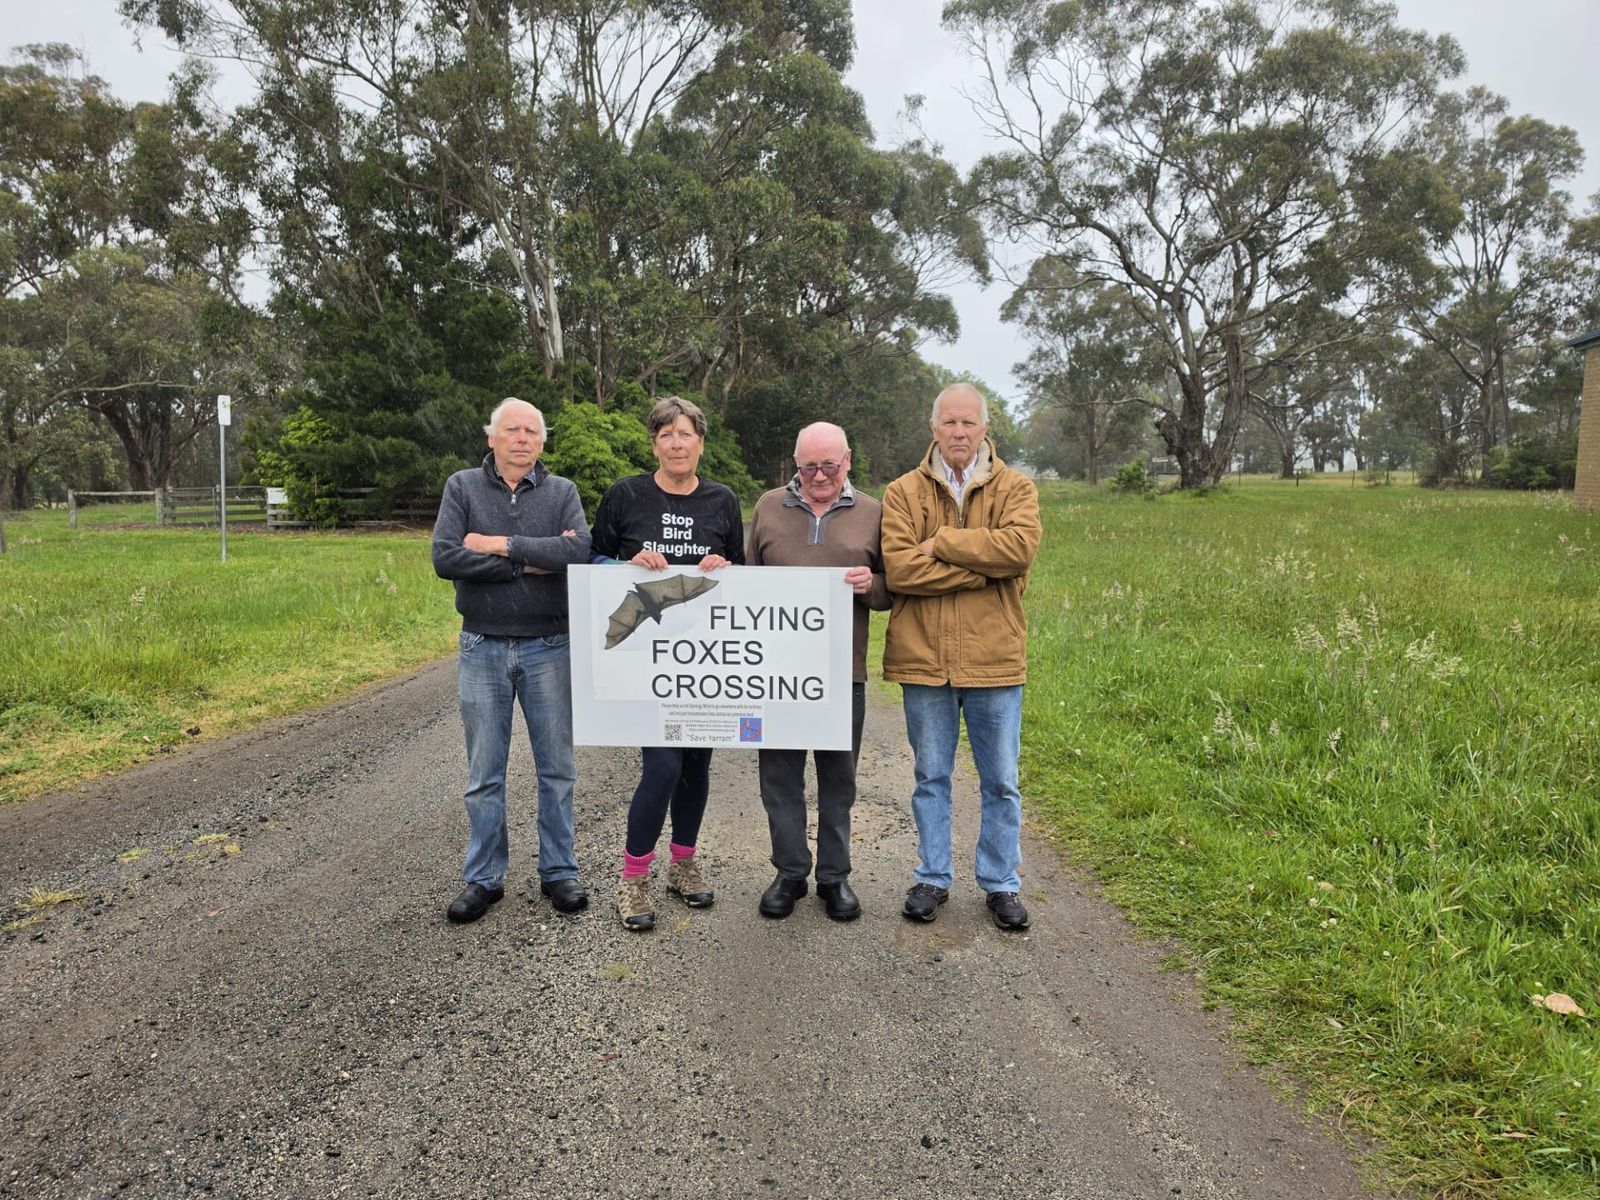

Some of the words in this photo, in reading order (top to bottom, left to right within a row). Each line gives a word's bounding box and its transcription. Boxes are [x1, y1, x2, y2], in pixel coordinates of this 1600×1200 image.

[662, 512, 694, 528] Stop
[663, 527, 692, 540] Bird
[643, 541, 711, 557] Slaughter
[711, 605, 825, 632] FLYING
[652, 639, 763, 666] FOXES
[652, 673, 824, 701] CROSSING
